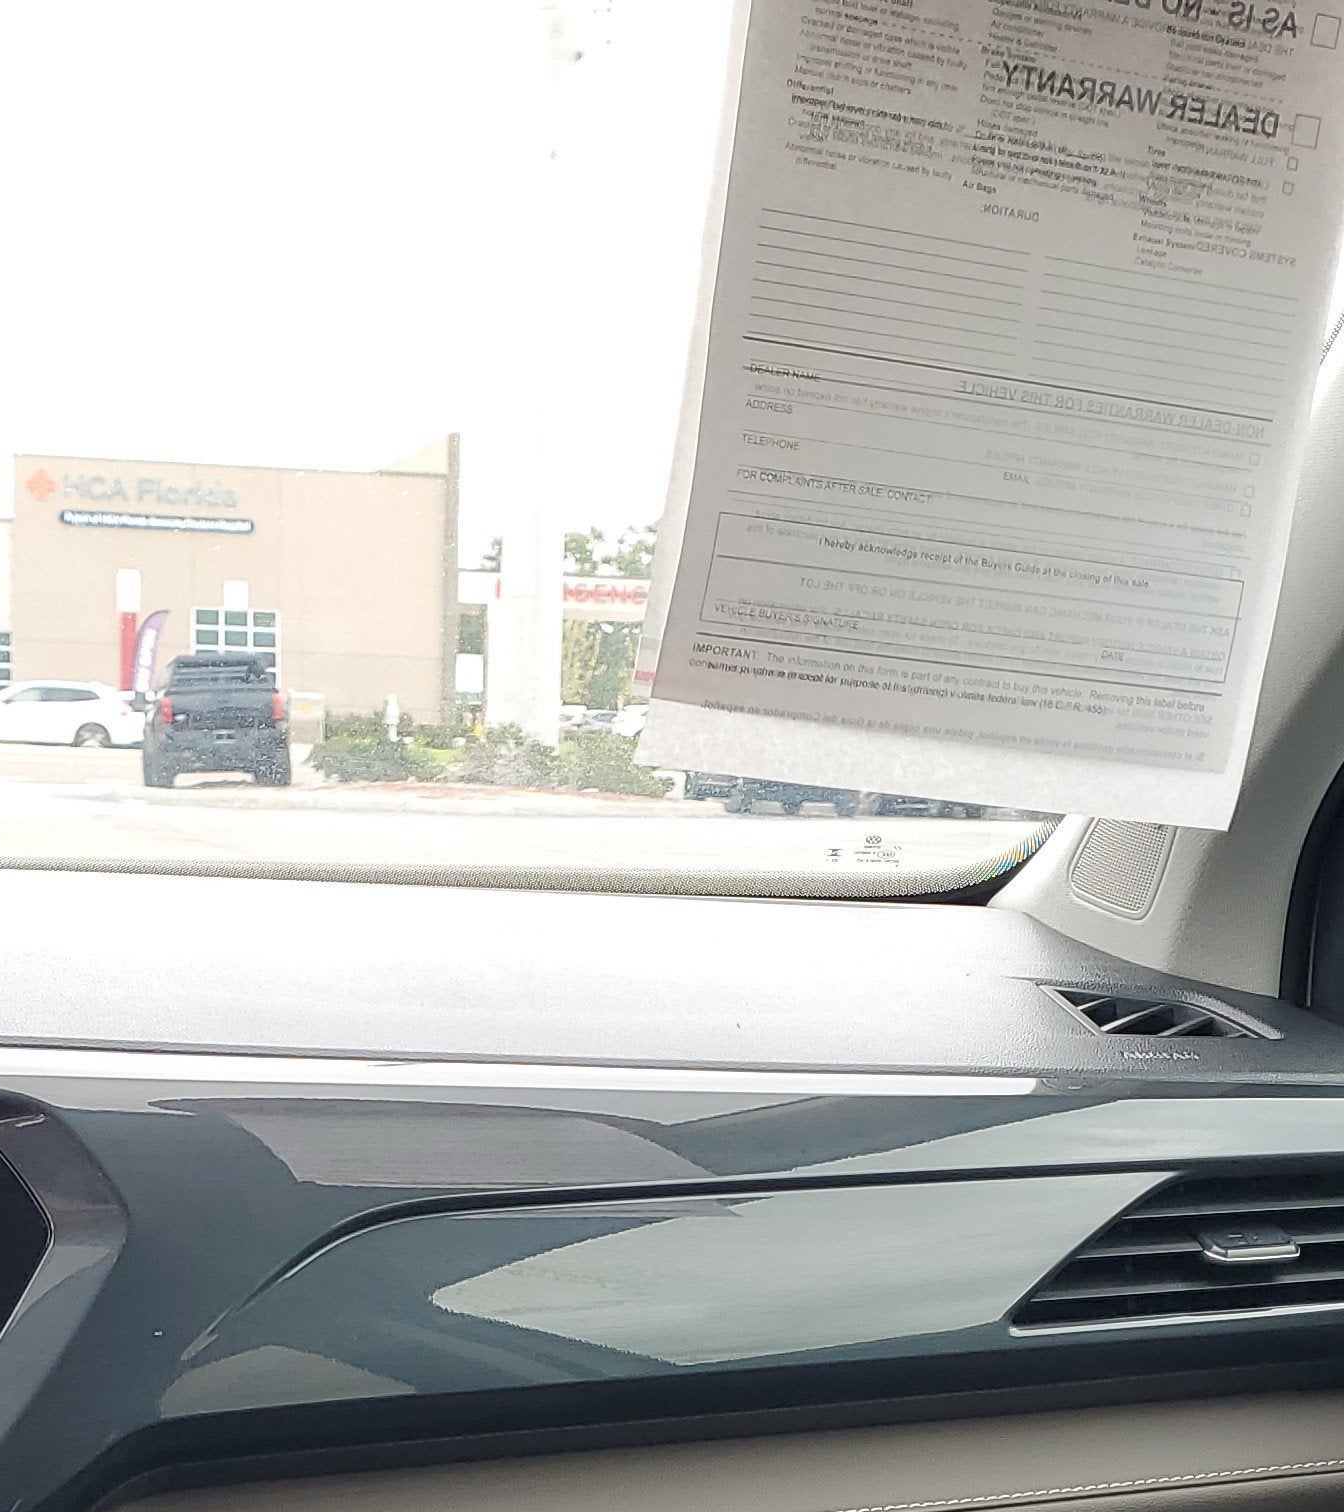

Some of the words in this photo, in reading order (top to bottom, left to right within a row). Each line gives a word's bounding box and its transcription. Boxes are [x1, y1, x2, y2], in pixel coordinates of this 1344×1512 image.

[745, 398, 793, 414] ADDRESS
[742, 432, 801, 450] TELEPHONE
[736, 468, 757, 481] FOR
[62, 472, 128, 505] HCA
[136, 476, 239, 510] Florida
